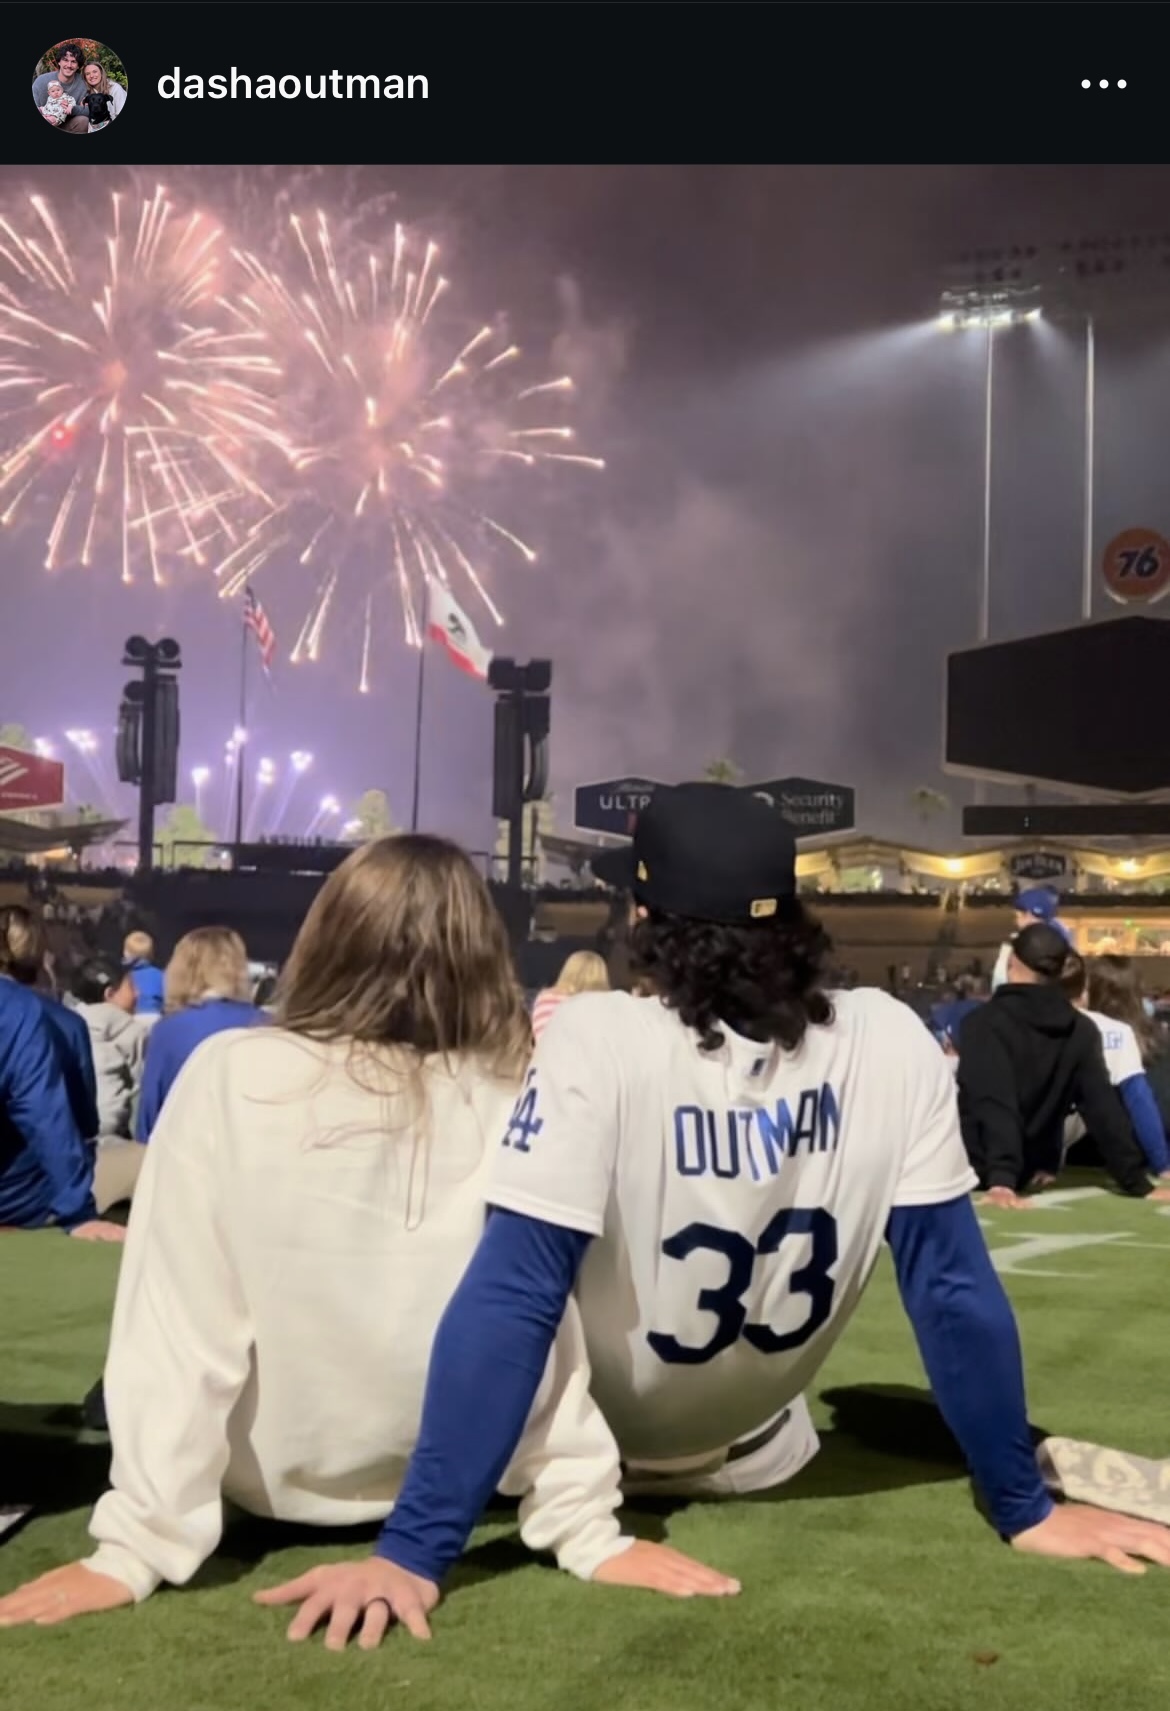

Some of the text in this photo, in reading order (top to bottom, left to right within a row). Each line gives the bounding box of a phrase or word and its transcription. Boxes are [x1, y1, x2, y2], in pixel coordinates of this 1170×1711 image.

[1118, 546, 1159, 578] 76
[599, 794, 652, 810] ULTR
[781, 791, 844, 811] Security
[674, 1081, 841, 1181] OUTMAN
[646, 1206, 838, 1365] 33
